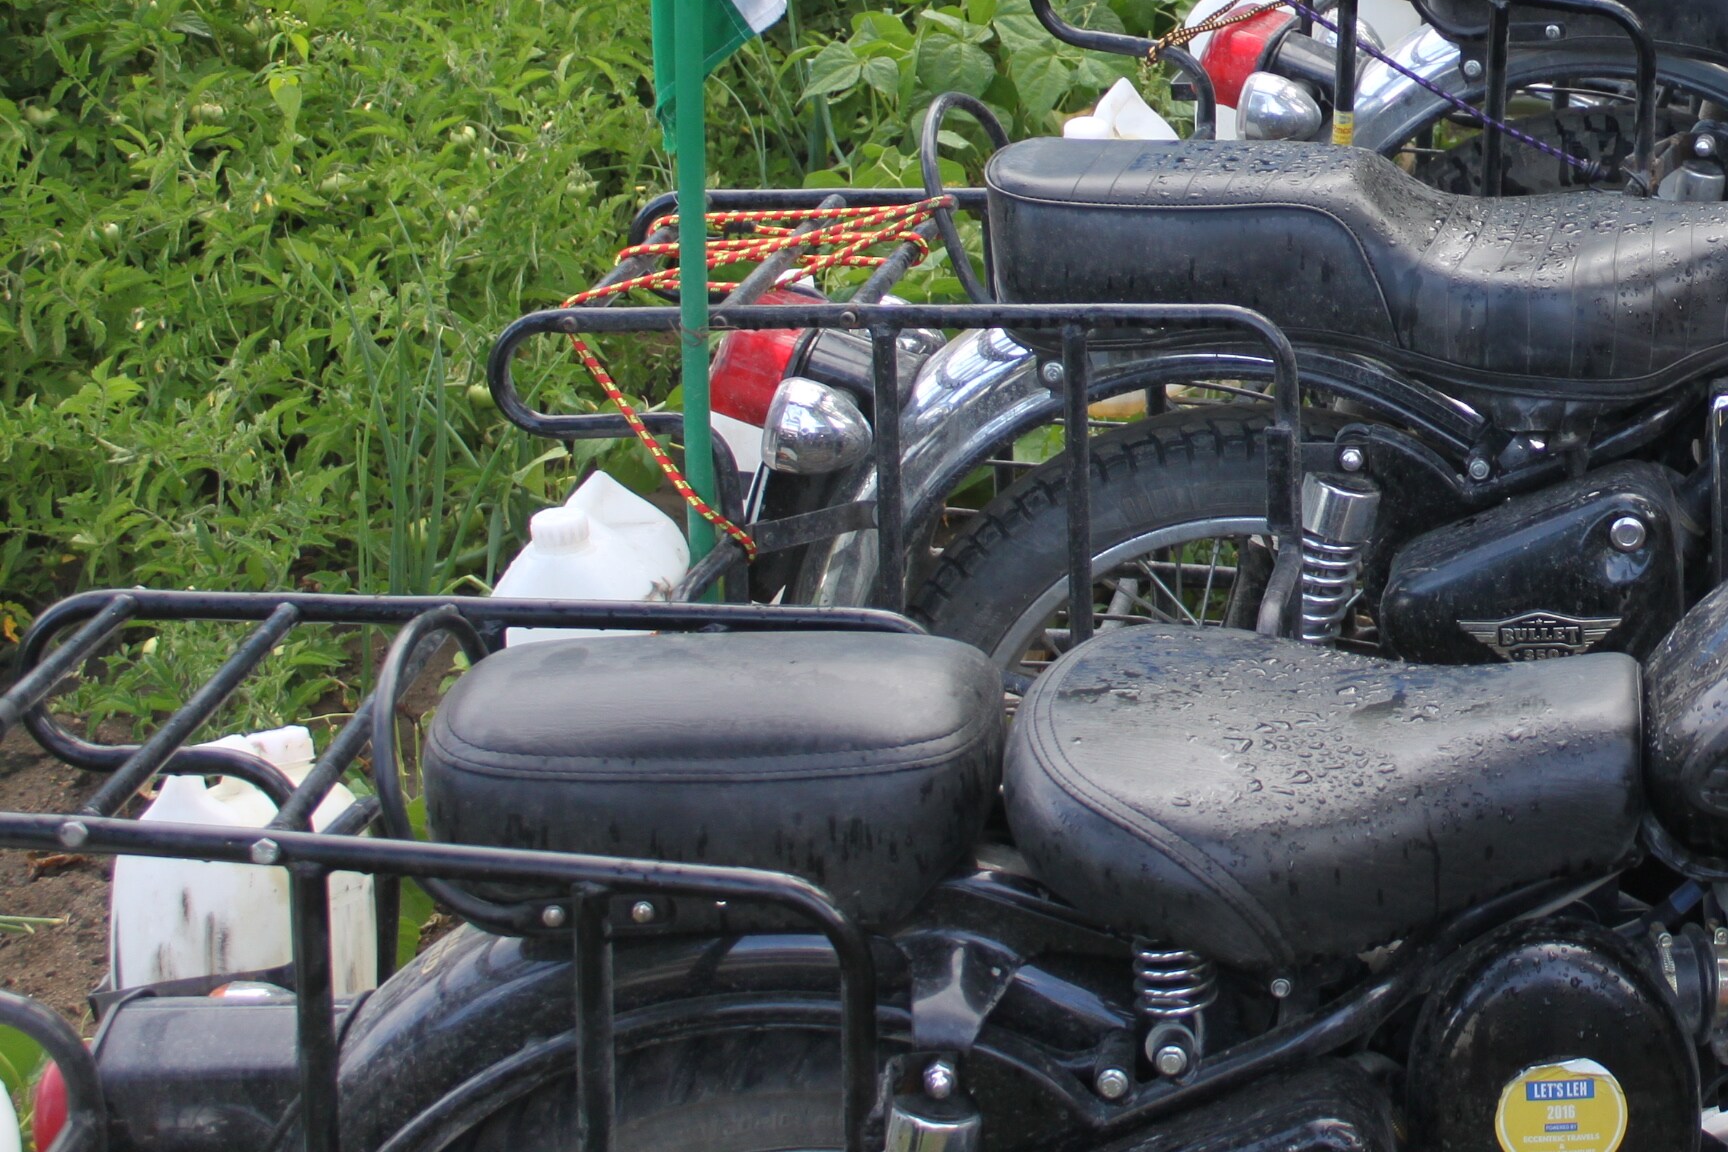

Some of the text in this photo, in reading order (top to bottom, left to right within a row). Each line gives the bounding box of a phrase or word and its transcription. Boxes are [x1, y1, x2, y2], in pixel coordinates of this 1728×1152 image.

[1501, 626, 1579, 645] BULLET
[1523, 648, 1560, 661] 350
[1534, 1080, 1588, 1098] LET'S LEH
[1546, 1104, 1576, 1120] 2016
